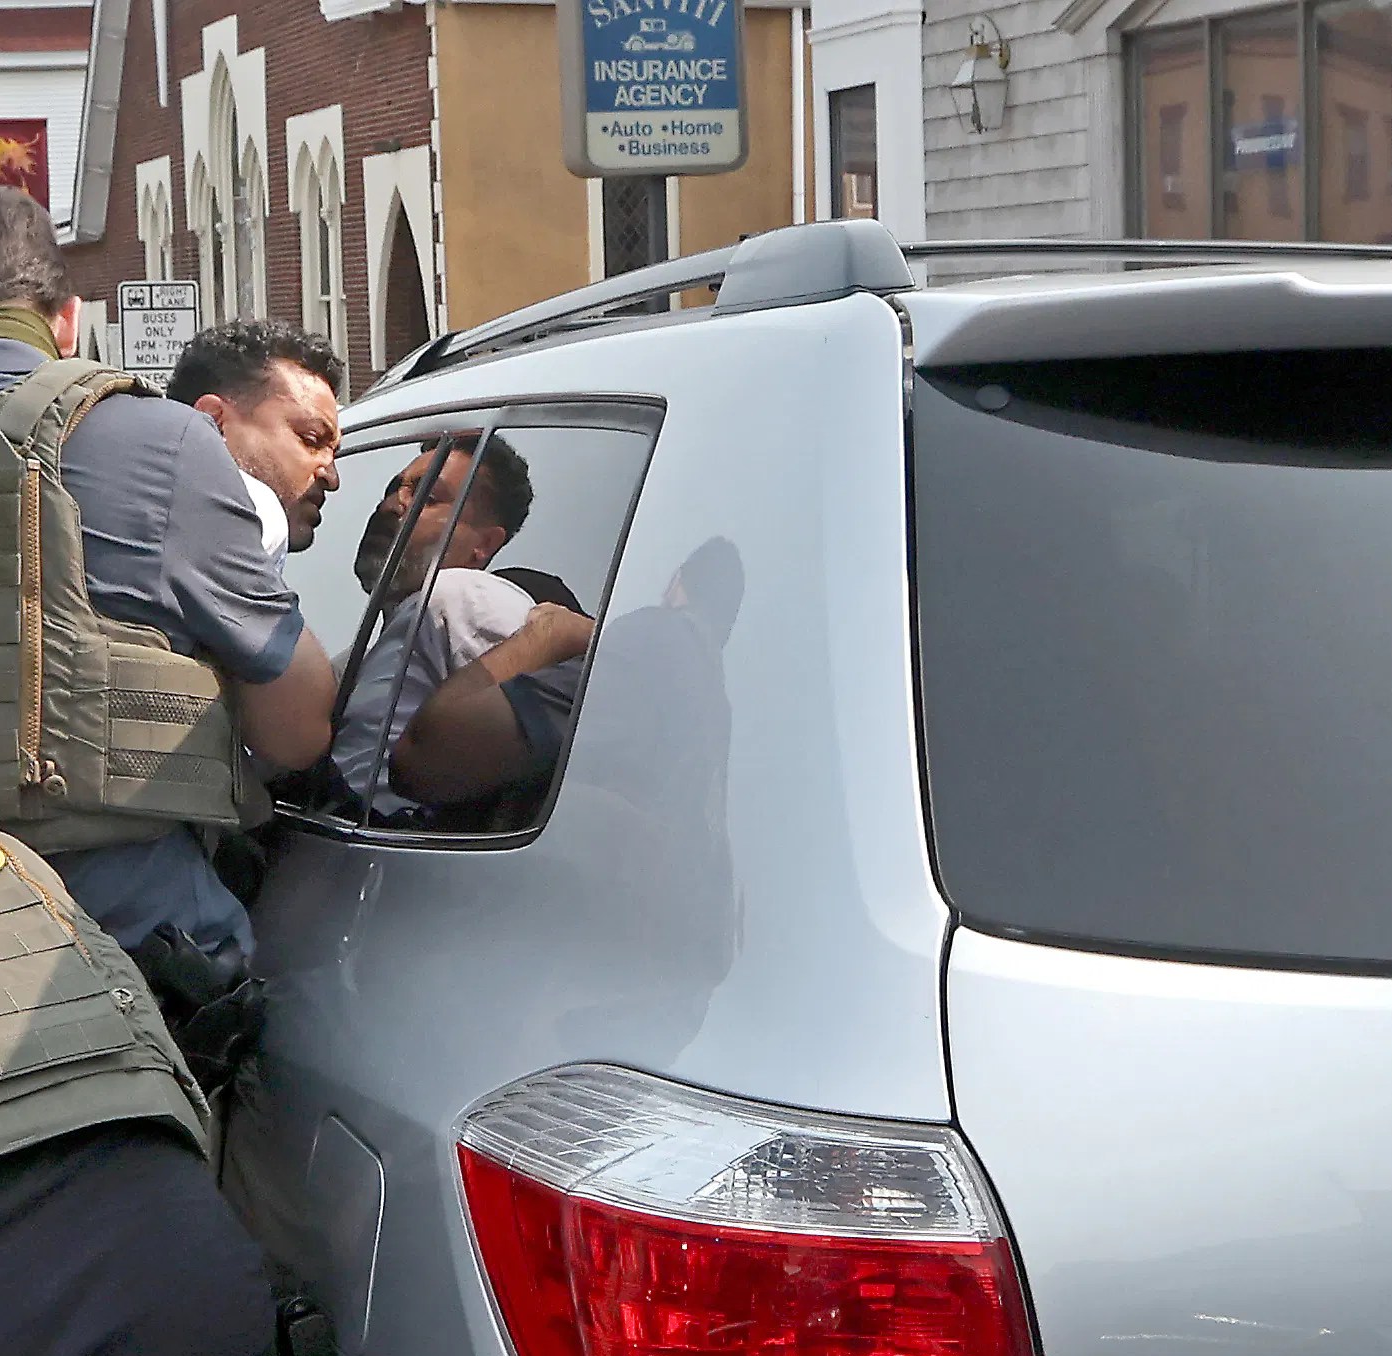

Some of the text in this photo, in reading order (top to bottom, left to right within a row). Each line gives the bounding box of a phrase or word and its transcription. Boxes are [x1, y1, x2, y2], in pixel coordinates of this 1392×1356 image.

[594, 59, 727, 82] INSURANCE
[614, 84, 708, 107] AGENCY
[610, 120, 723, 137] Auto Home
[628, 139, 711, 156] Business
[162, 298, 186, 307] LANE
[142, 312, 177, 323] BUSES
[145, 326, 175, 337] ONLY
[134, 340, 156, 350] 4PM
[136, 354, 159, 364] MON
